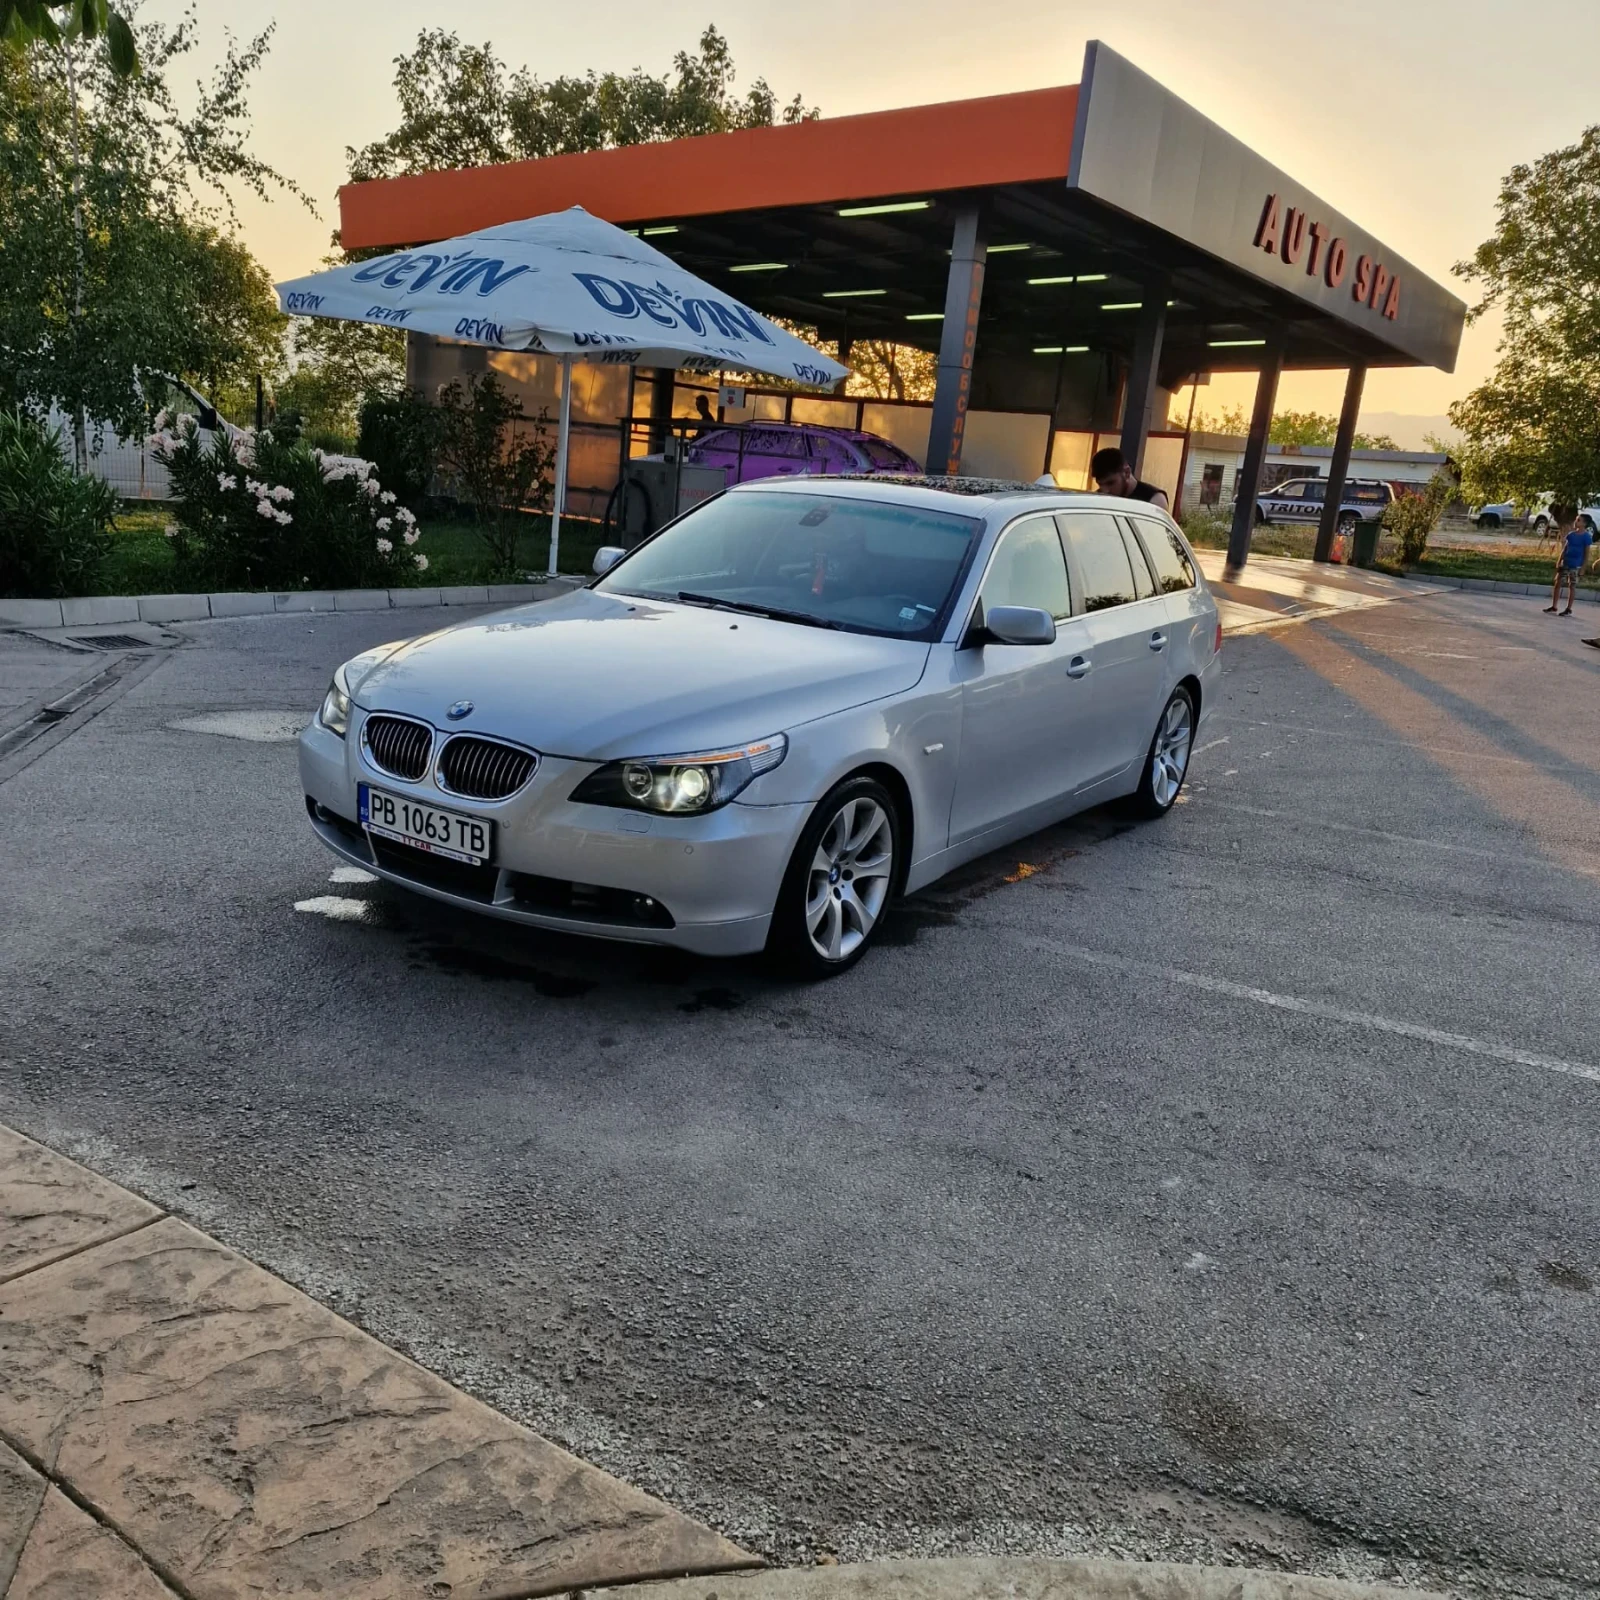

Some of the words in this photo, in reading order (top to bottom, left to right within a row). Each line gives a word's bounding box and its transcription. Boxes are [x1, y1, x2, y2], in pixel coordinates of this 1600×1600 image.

[351, 250, 532, 297] DEVIN
[1253, 193, 1348, 288] AUTO
[1353, 254, 1401, 321] SPA
[286, 292, 326, 310] DEVIN
[365, 306, 412, 322] DEVIN
[571, 273, 777, 347] DEVIN
[455, 317, 505, 345] DEVIN
[793, 362, 832, 385] DEVIN
[402, 804, 450, 843] 1063
